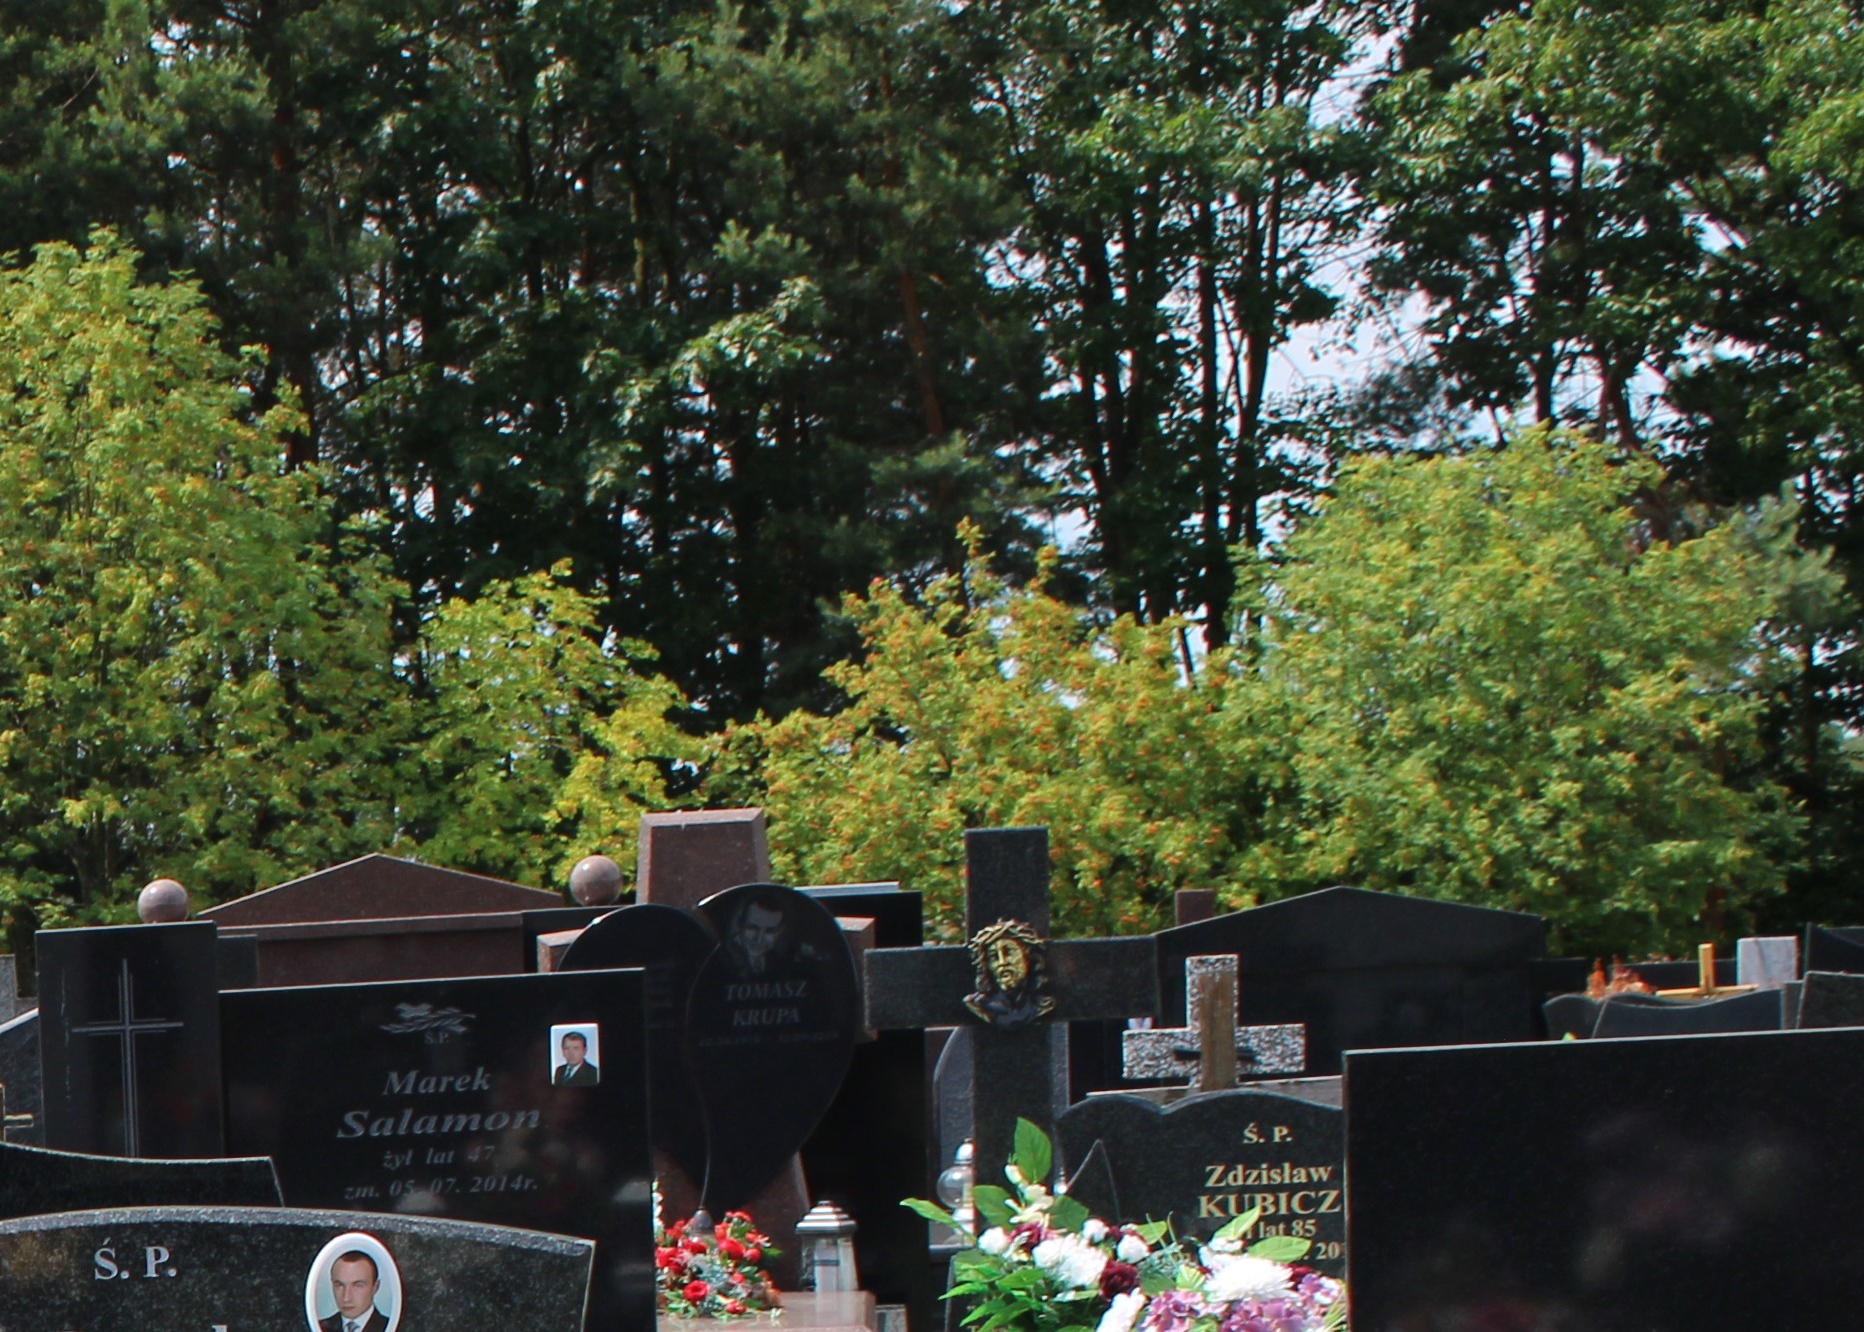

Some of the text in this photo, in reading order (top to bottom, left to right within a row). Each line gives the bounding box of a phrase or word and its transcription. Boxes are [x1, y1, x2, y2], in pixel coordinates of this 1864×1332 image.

[383, 1066, 491, 1096] Marek
[336, 1108, 540, 1139] Salamon
[1243, 1122, 1293, 1144] Ś. P.
[426, 1147, 455, 1165] lat
[467, 1145, 495, 1163] 47
[344, 1186, 380, 1200] zm.
[389, 1178, 419, 1197] 05
[469, 1174, 539, 1193] 2014r.
[1205, 1162, 1332, 1187] Zdzisław
[1198, 1190, 1342, 1218] KUBICZ
[1291, 1219, 1316, 1238] 85
[95, 1237, 176, 1280] Ś. P.
